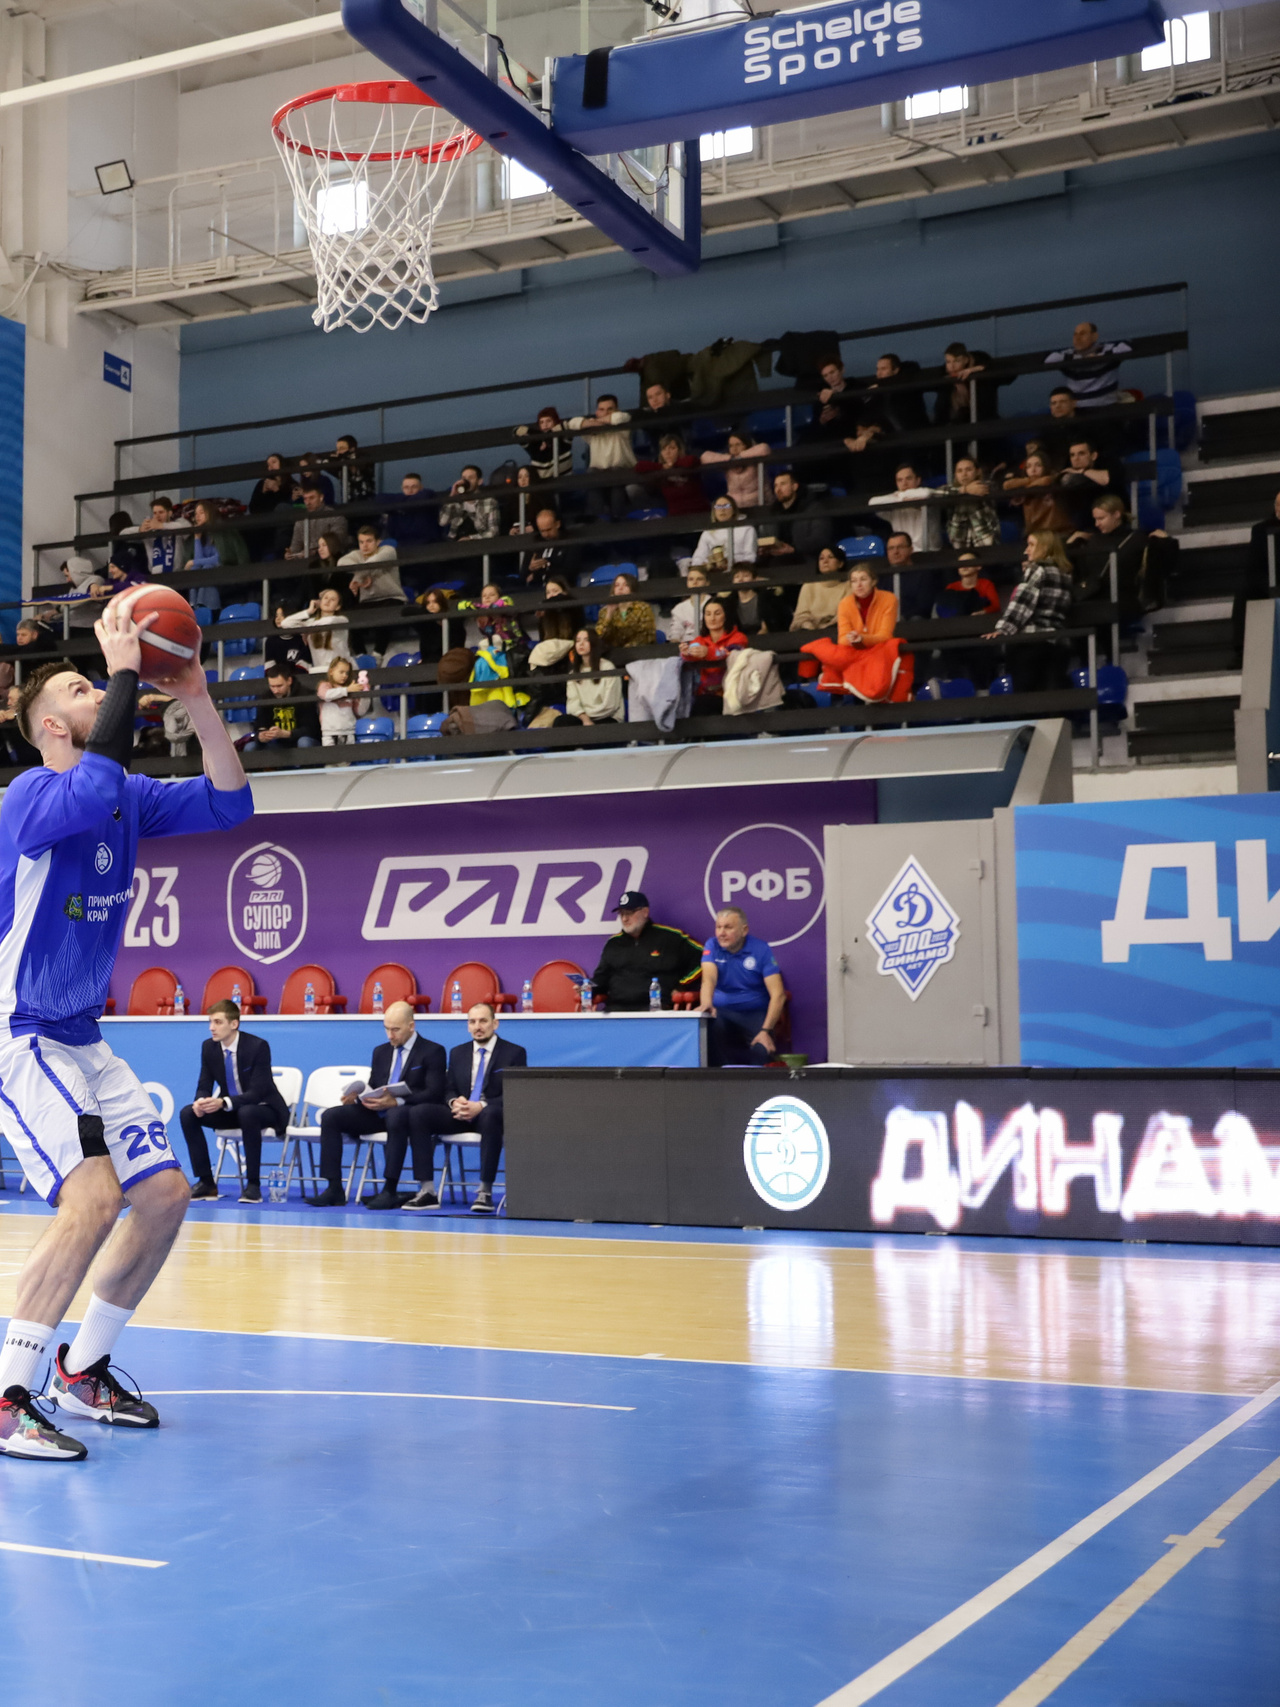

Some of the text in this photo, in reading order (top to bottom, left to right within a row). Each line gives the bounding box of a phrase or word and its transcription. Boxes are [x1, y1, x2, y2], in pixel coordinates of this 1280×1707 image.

[744, 0, 921, 56] Schelde
[744, 28, 923, 85] Sports
[373, 858, 632, 929] PARI
[721, 867, 812, 903] РФБ
[87, 908, 109, 922] КРАЙ
[243, 904, 292, 930] СУПЕР
[253, 931, 281, 950] ЛИГА
[883, 946, 948, 969] ДИНАМО
[119, 1120, 168, 1161] 26
